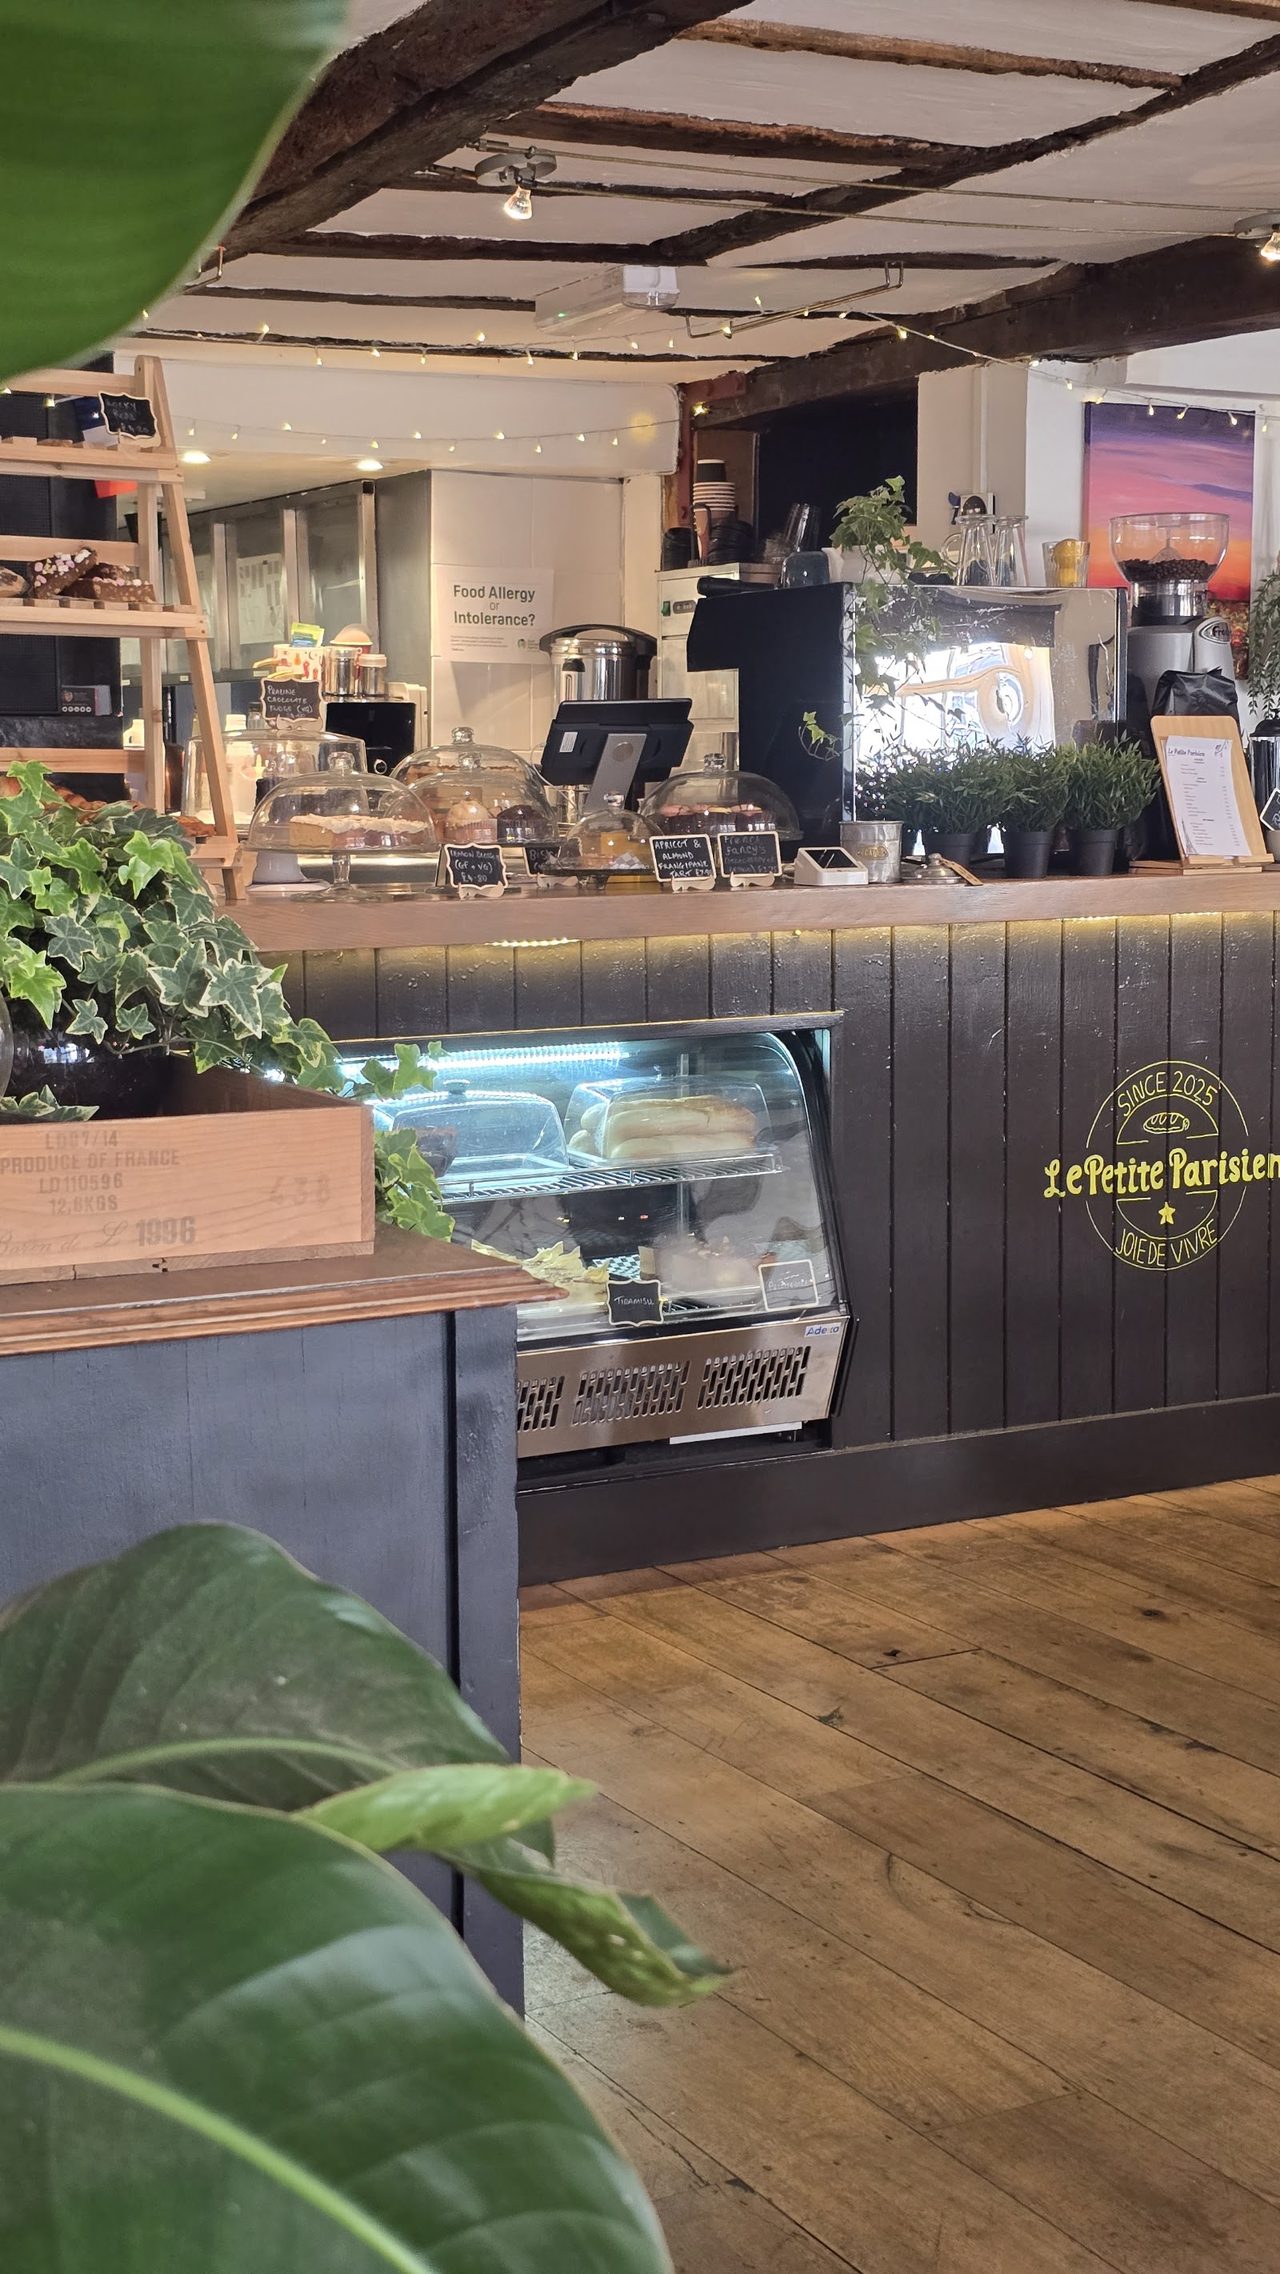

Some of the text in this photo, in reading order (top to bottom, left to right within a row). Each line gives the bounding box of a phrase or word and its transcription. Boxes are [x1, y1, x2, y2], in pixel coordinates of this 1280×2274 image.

[453, 585, 535, 603] Food Allergy
[489, 602, 500, 611] or
[454, 611, 535, 626] Intolerance?
[655, 839, 702, 849] APRICOT &
[662, 851, 694, 860] ALMOND
[670, 869, 692, 878] TART
[1117, 1070, 1218, 1117] SINCE 2025
[0, 1149, 180, 1175] PRODUCE OF FRANCE
[39, 1171, 124, 1195] LD110596
[1043, 1158, 1083, 1198] Le
[1084, 1154, 1165, 1196] Petite
[136, 1215, 197, 1248] 1996
[1115, 1218, 1218, 1267] JOIE DE VIVRE
